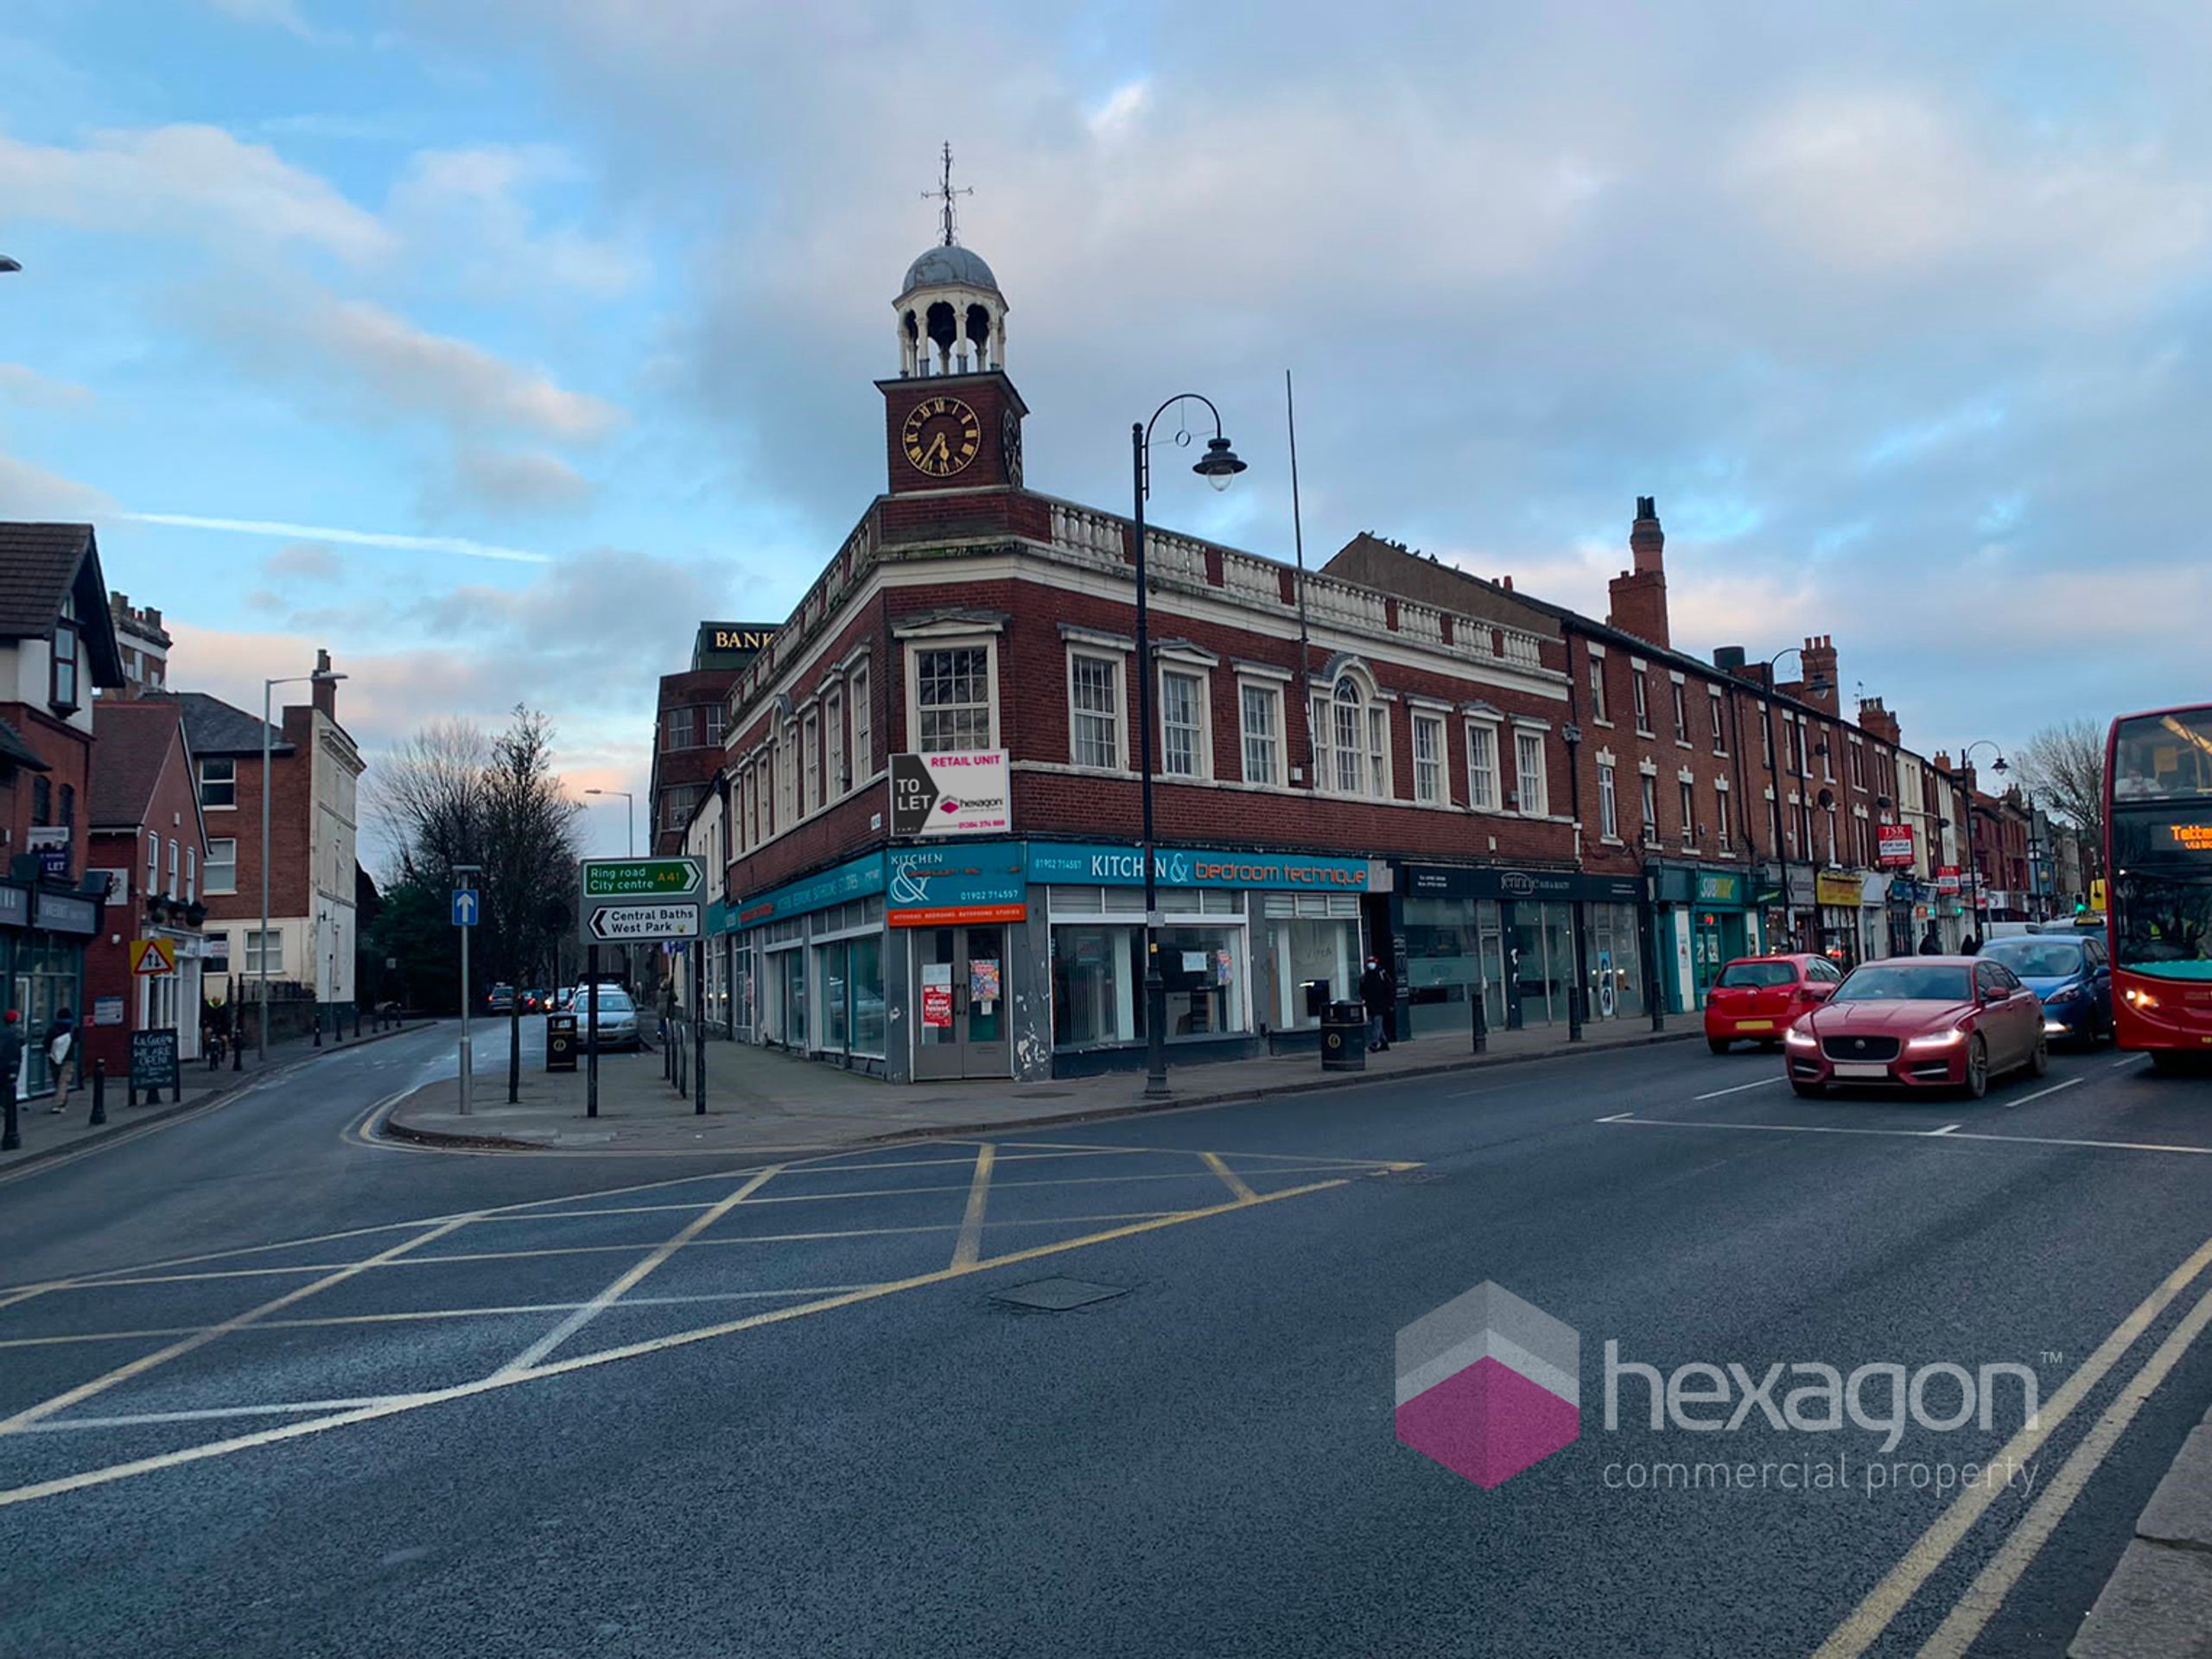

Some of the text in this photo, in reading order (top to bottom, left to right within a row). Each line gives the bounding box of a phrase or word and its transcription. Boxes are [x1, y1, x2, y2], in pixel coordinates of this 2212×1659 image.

[931, 754, 1001, 767] RETAIL UNIT
[897, 779, 920, 793] TO
[898, 795, 931, 810] LET
[959, 798, 1002, 808] hexagon
[891, 853, 943, 865] KITCHEN
[48, 861, 65, 871] LET
[1091, 853, 1367, 886] KITCHN & bedroom technique
[591, 867, 646, 879] Ring road
[590, 879, 654, 891] City centre
[890, 861, 931, 903] &
[961, 891, 987, 900] 01902
[612, 908, 694, 921] Central Baths
[612, 921, 671, 933] West Park
